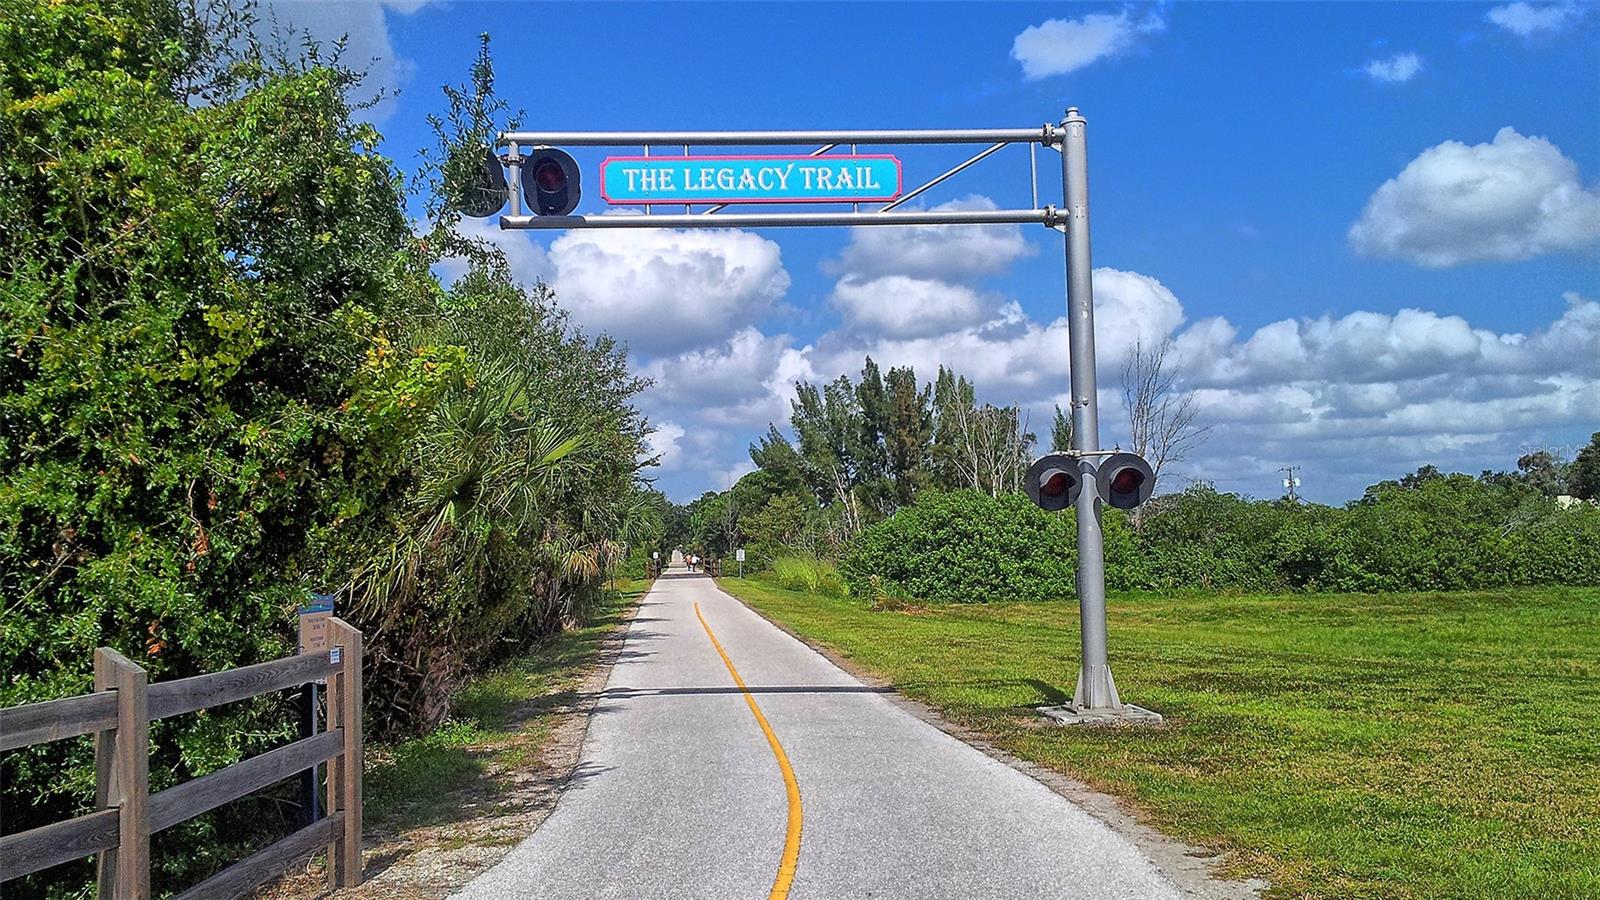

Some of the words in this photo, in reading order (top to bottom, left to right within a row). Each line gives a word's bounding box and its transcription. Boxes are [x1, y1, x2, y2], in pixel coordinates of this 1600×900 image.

[623, 168, 675, 192] THE
[684, 162, 796, 192] LEGACY
[799, 166, 881, 190] TRAIL
